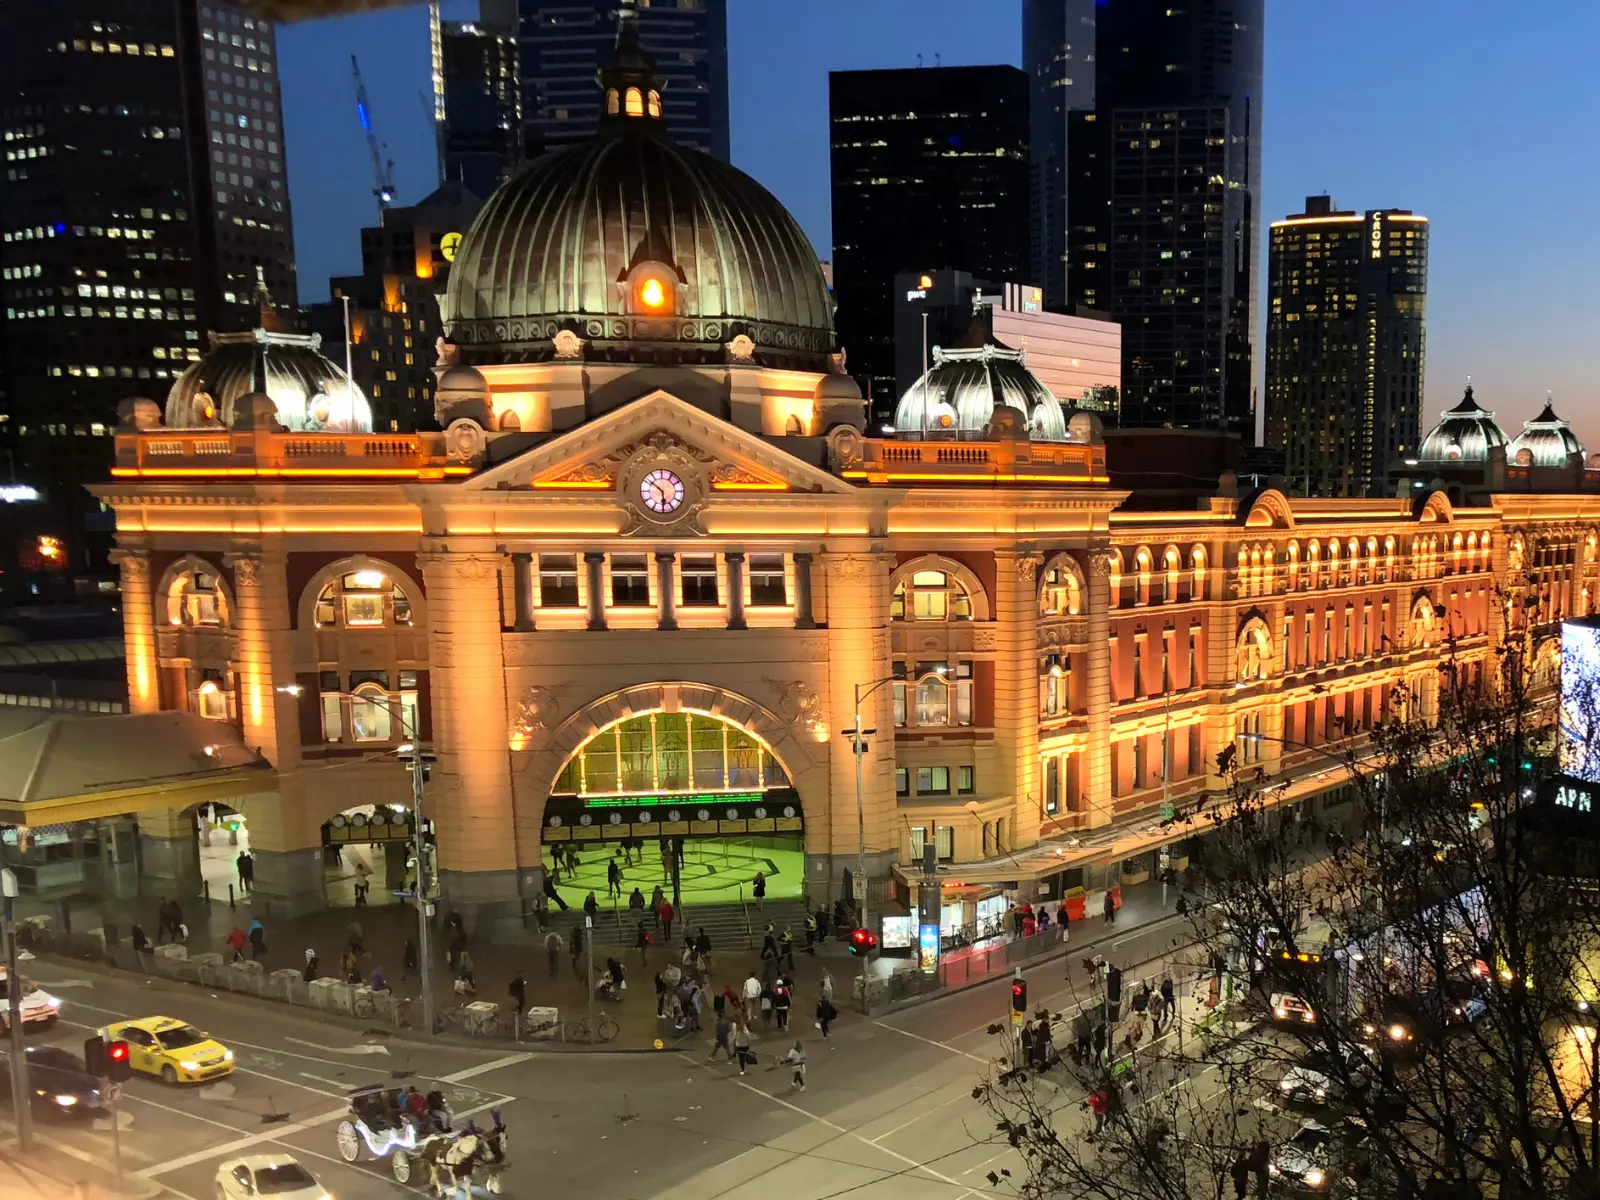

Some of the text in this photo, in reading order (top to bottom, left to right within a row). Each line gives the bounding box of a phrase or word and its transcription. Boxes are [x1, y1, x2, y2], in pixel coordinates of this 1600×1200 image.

[1371, 211, 1382, 259] CROWN
[907, 290, 926, 302] pwc
[1554, 786, 1592, 813] APN
